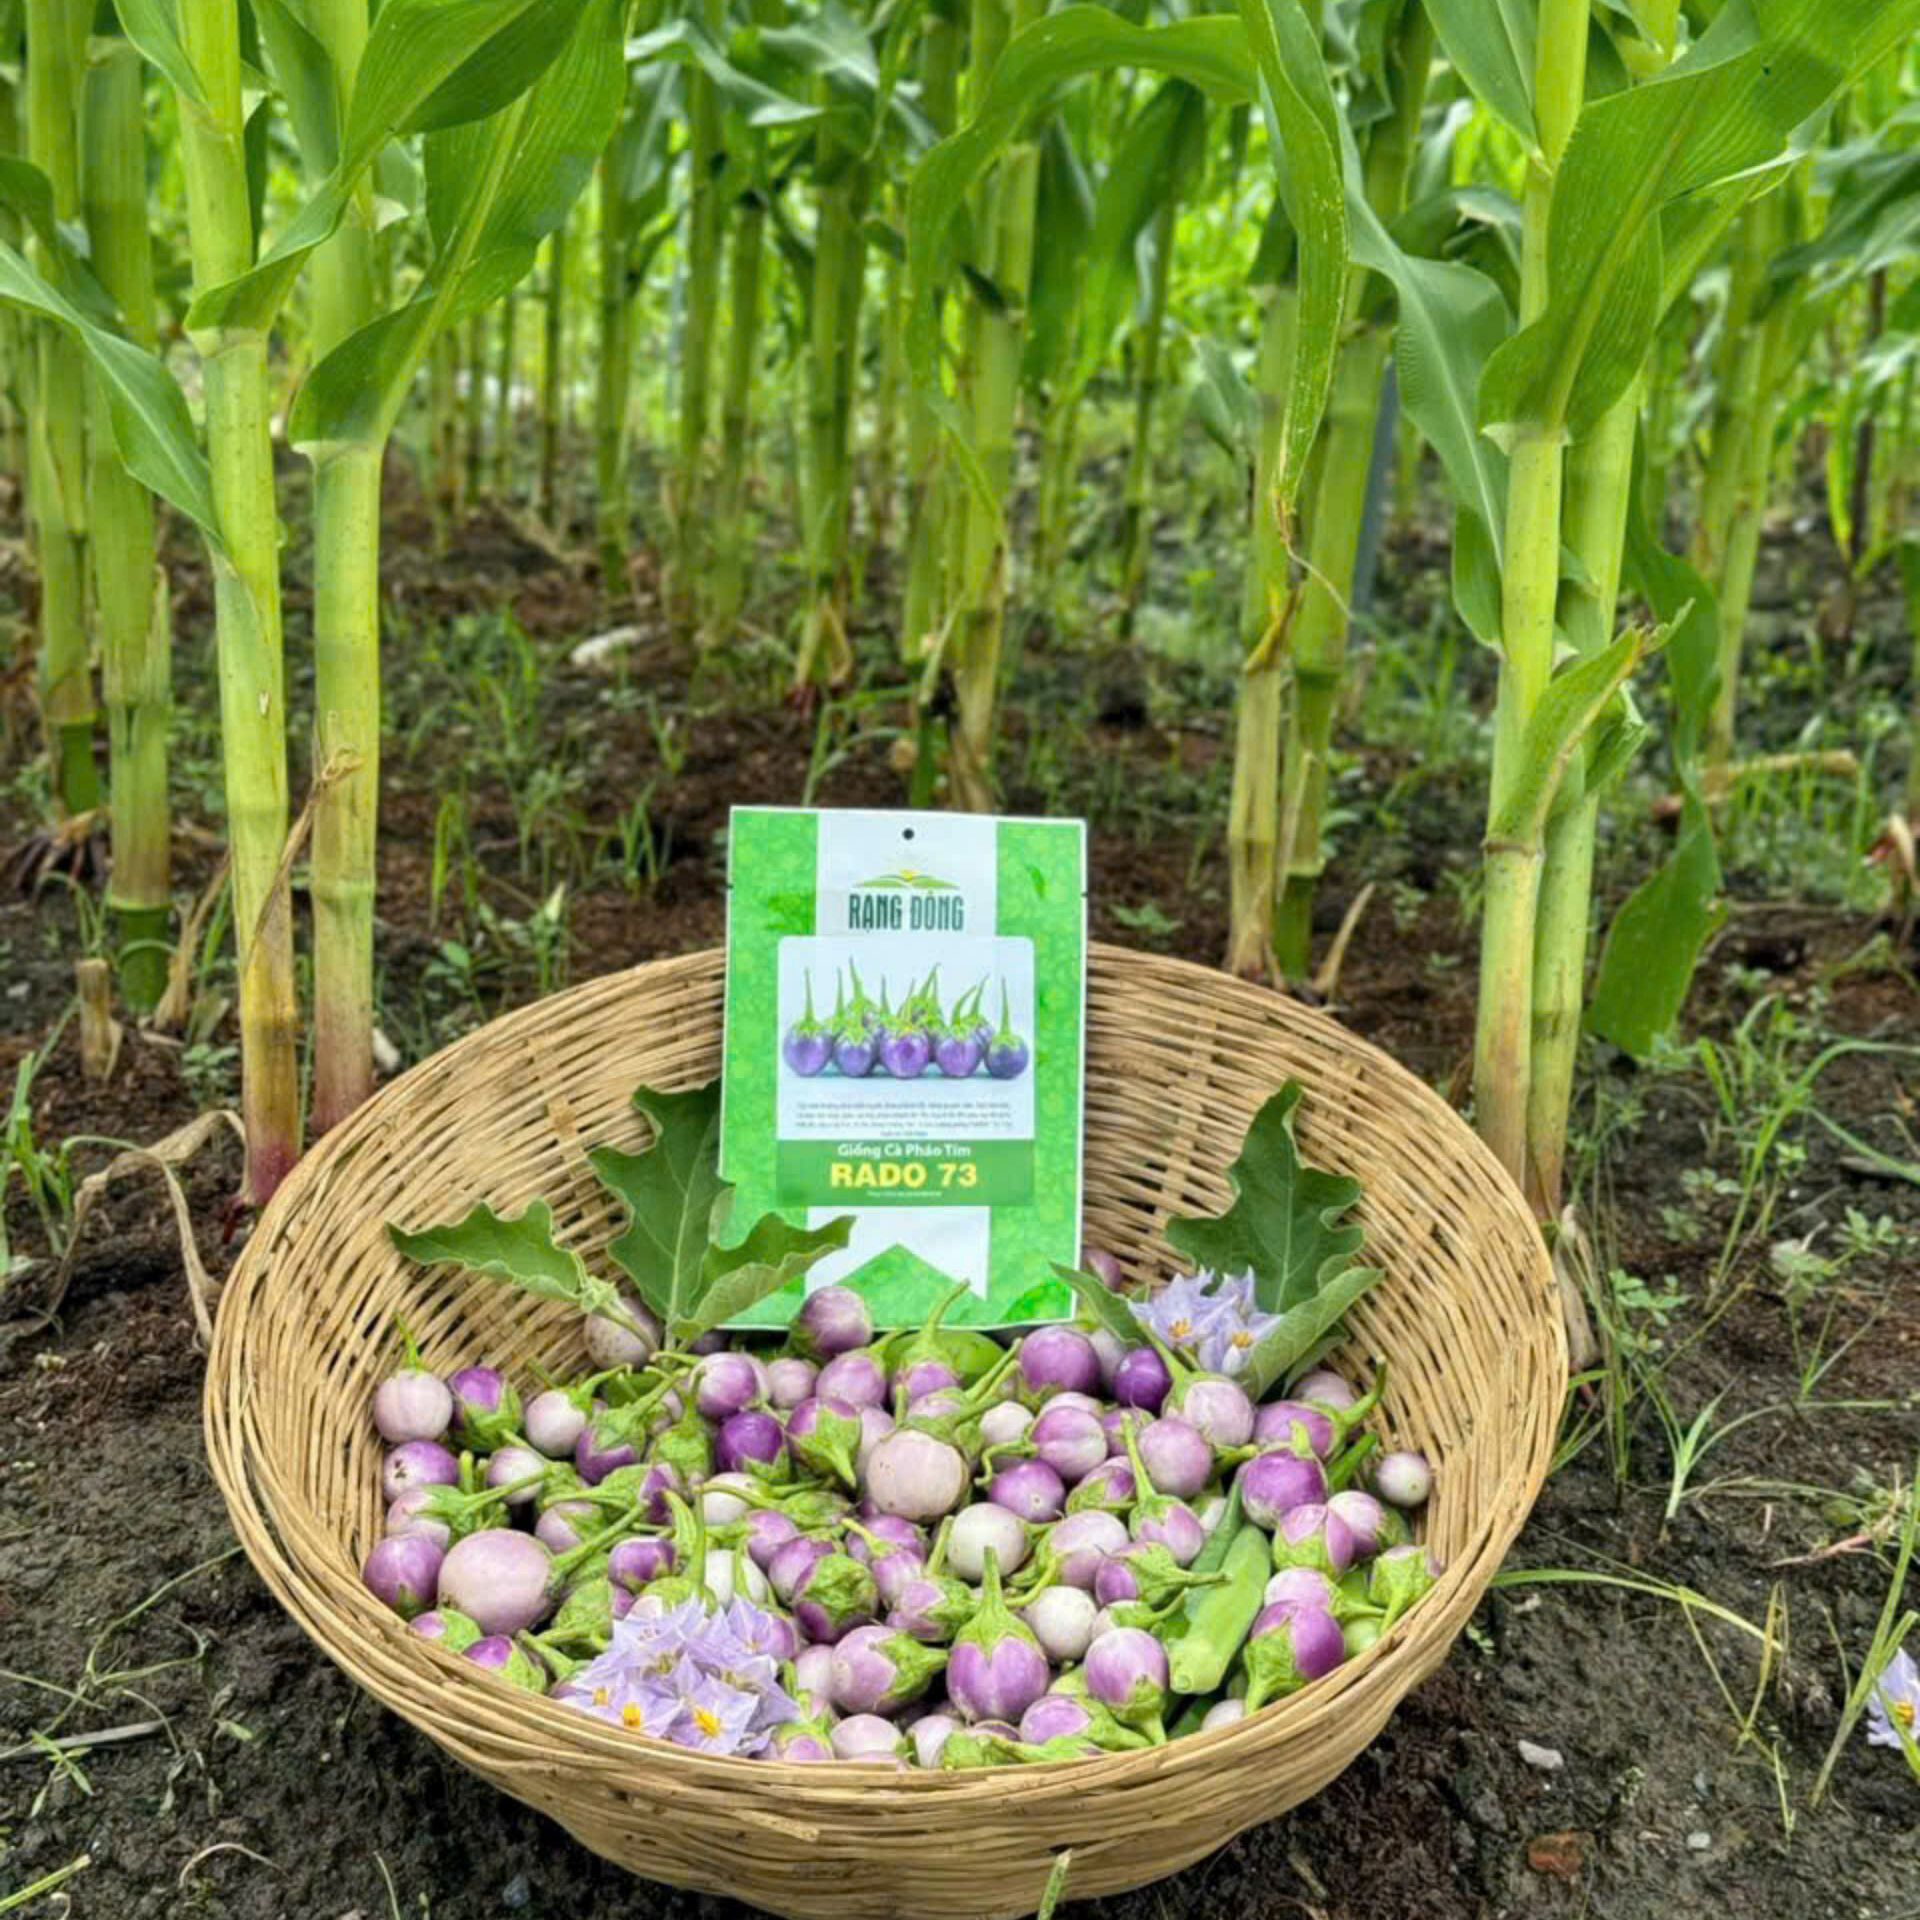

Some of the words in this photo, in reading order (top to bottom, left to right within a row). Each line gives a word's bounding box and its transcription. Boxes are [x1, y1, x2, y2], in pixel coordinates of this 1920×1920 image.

[849, 893, 902, 933] RẠNG
[831, 1162, 927, 1188] RADO
[937, 1162, 977, 1187] 73
